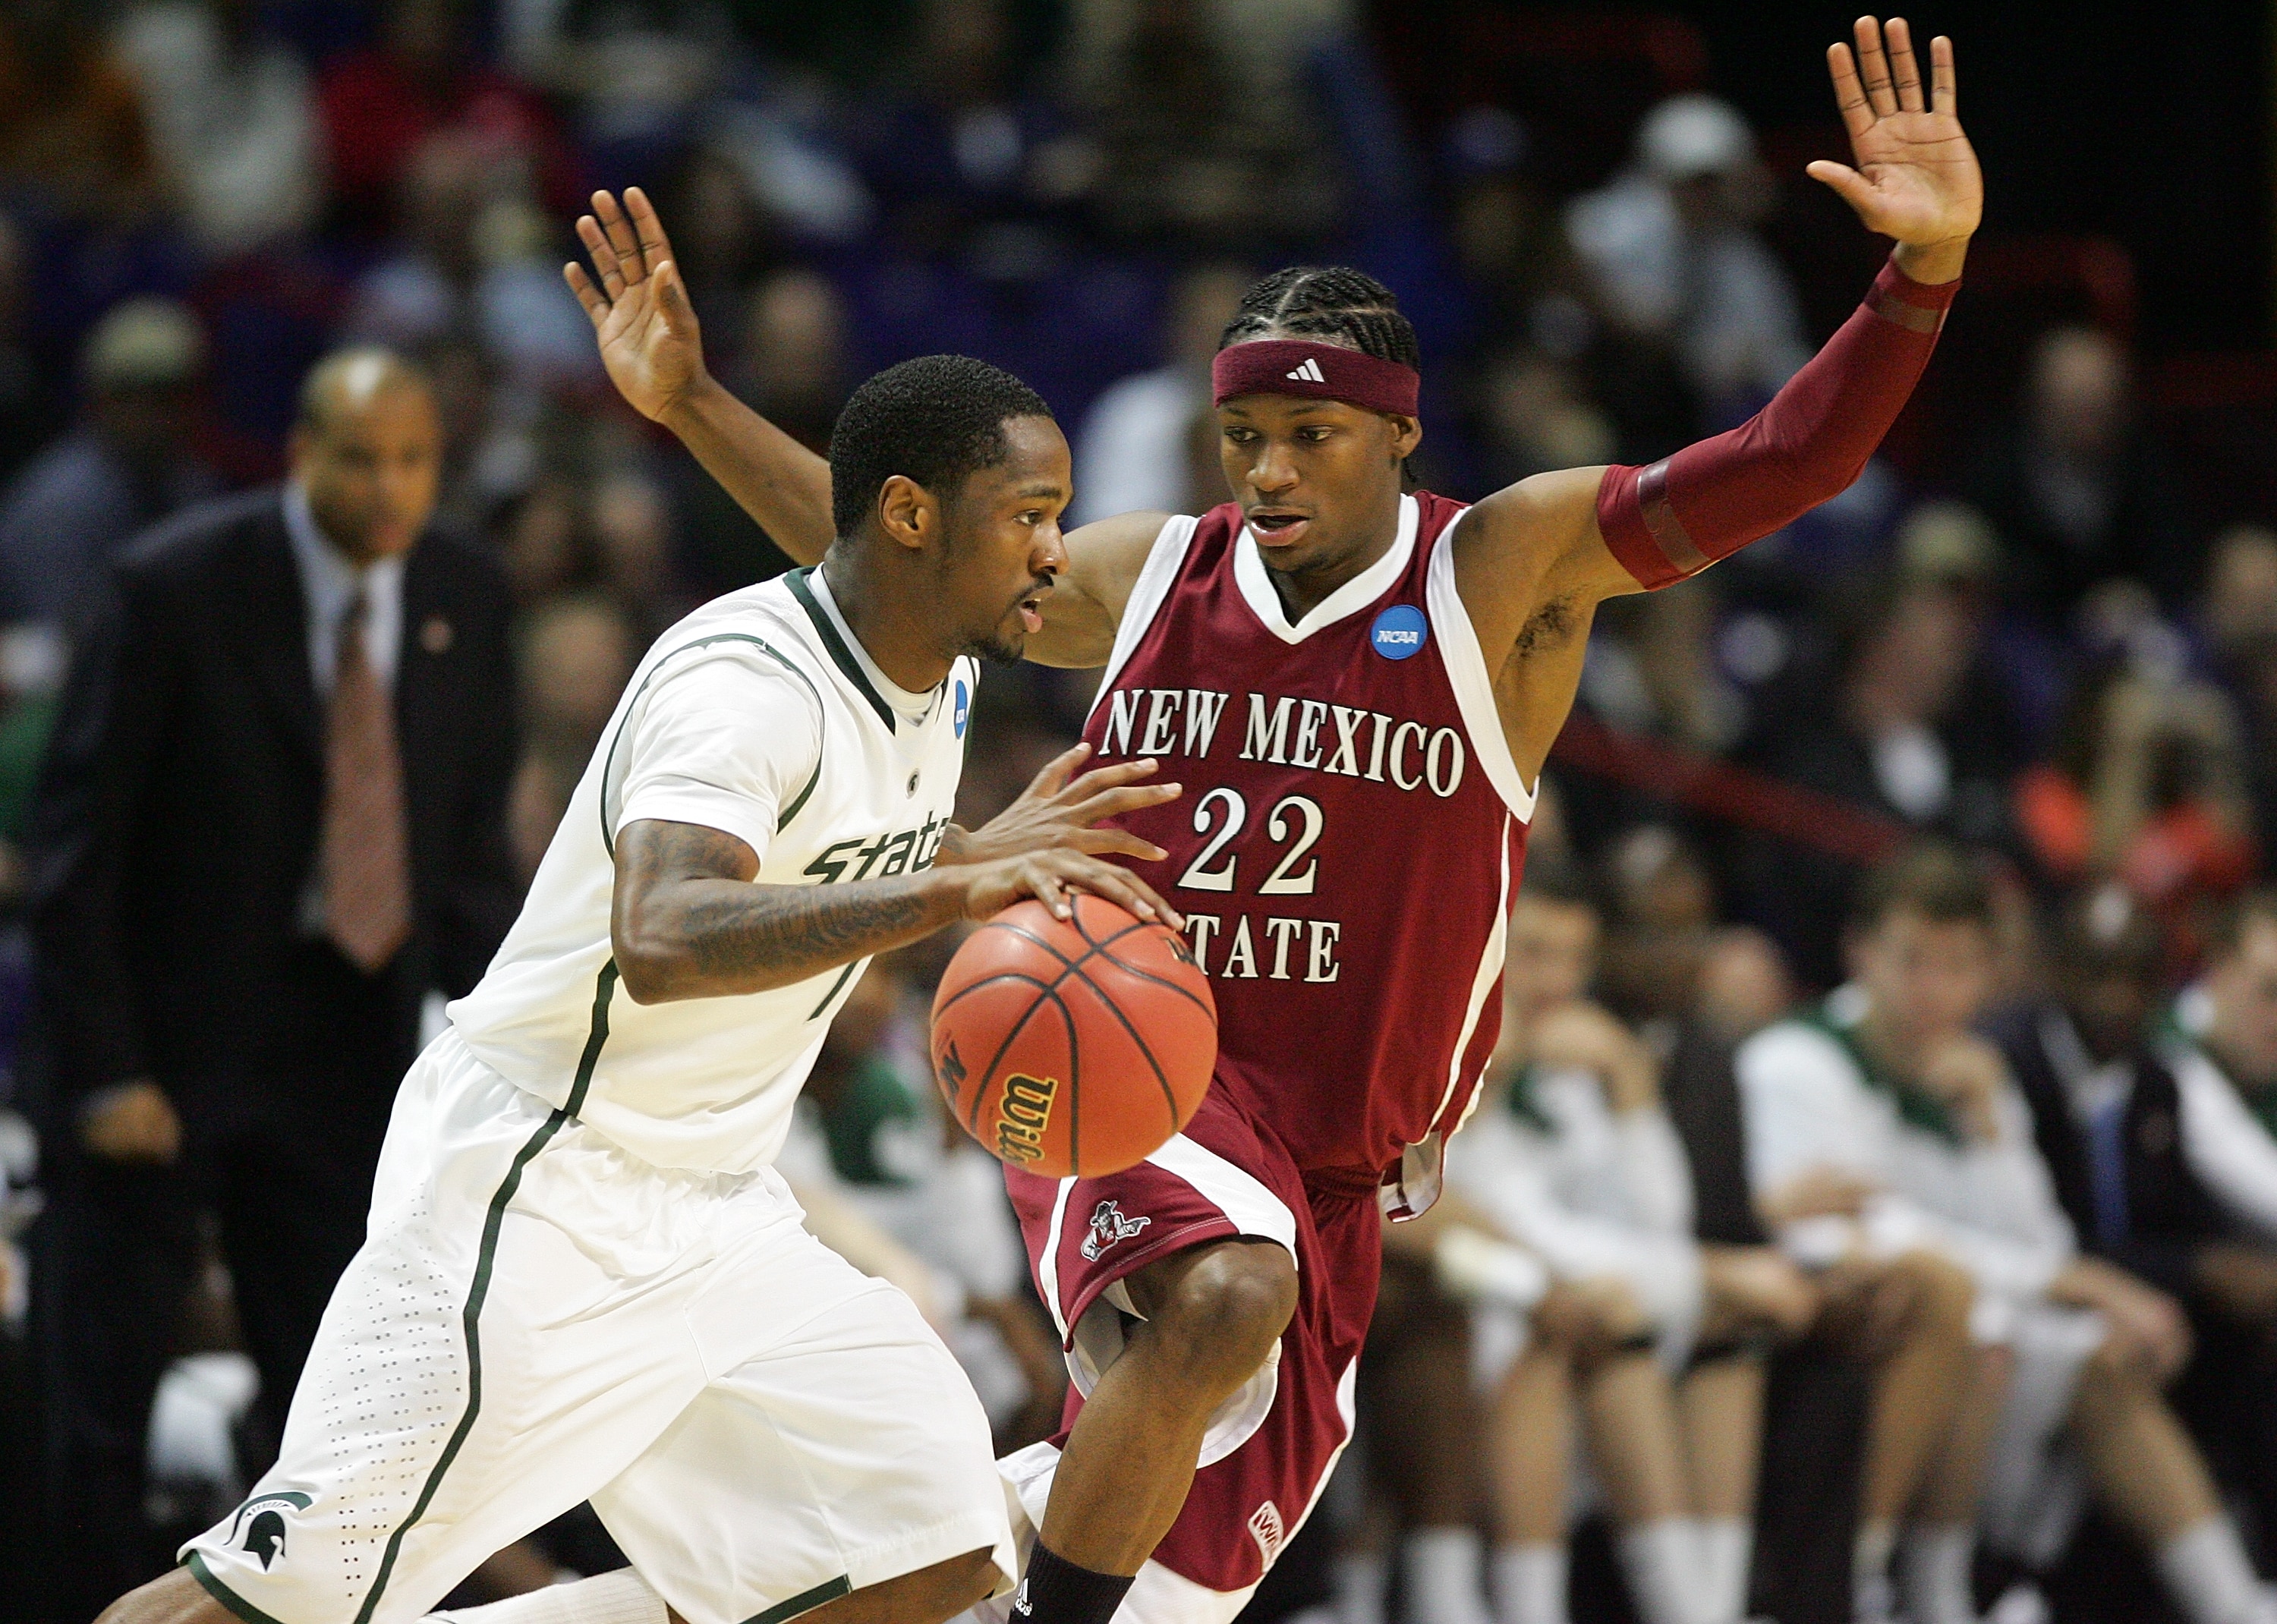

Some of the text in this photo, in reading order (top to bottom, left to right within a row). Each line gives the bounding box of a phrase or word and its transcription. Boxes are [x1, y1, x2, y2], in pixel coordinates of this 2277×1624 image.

[1376, 630, 1419, 645] NCAA
[1098, 688, 1466, 798] NEW MEXICO
[1176, 787, 1325, 895] 22
[1184, 914, 1342, 984] TATE
